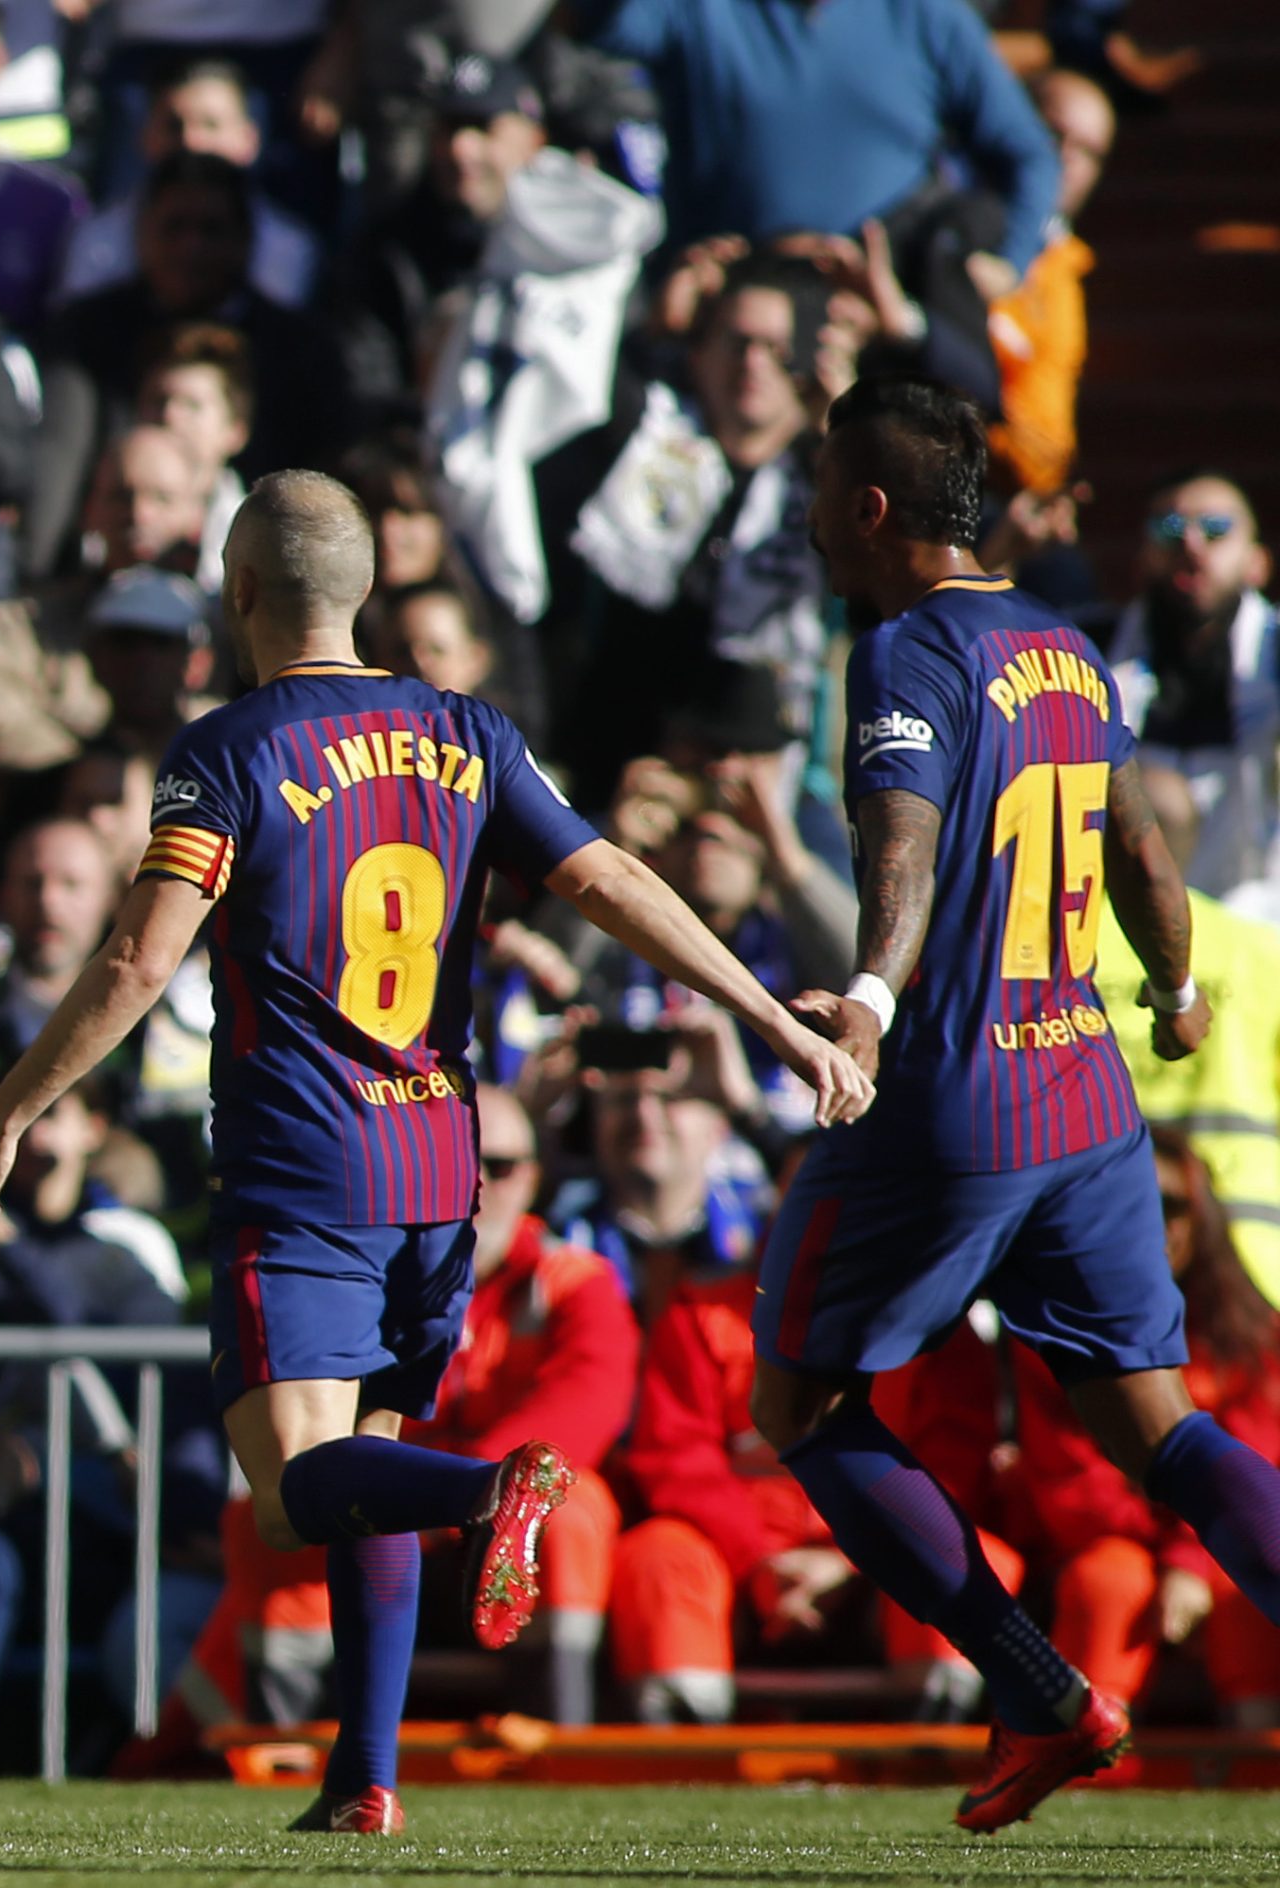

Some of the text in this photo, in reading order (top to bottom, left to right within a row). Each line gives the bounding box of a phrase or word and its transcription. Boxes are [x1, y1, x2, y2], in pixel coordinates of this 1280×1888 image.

[859, 711, 934, 745] beko
[154, 774, 201, 803] eko
[278, 731, 484, 825] A. INIESTA
[993, 761, 1111, 979] 15
[337, 842, 446, 1050] 8
